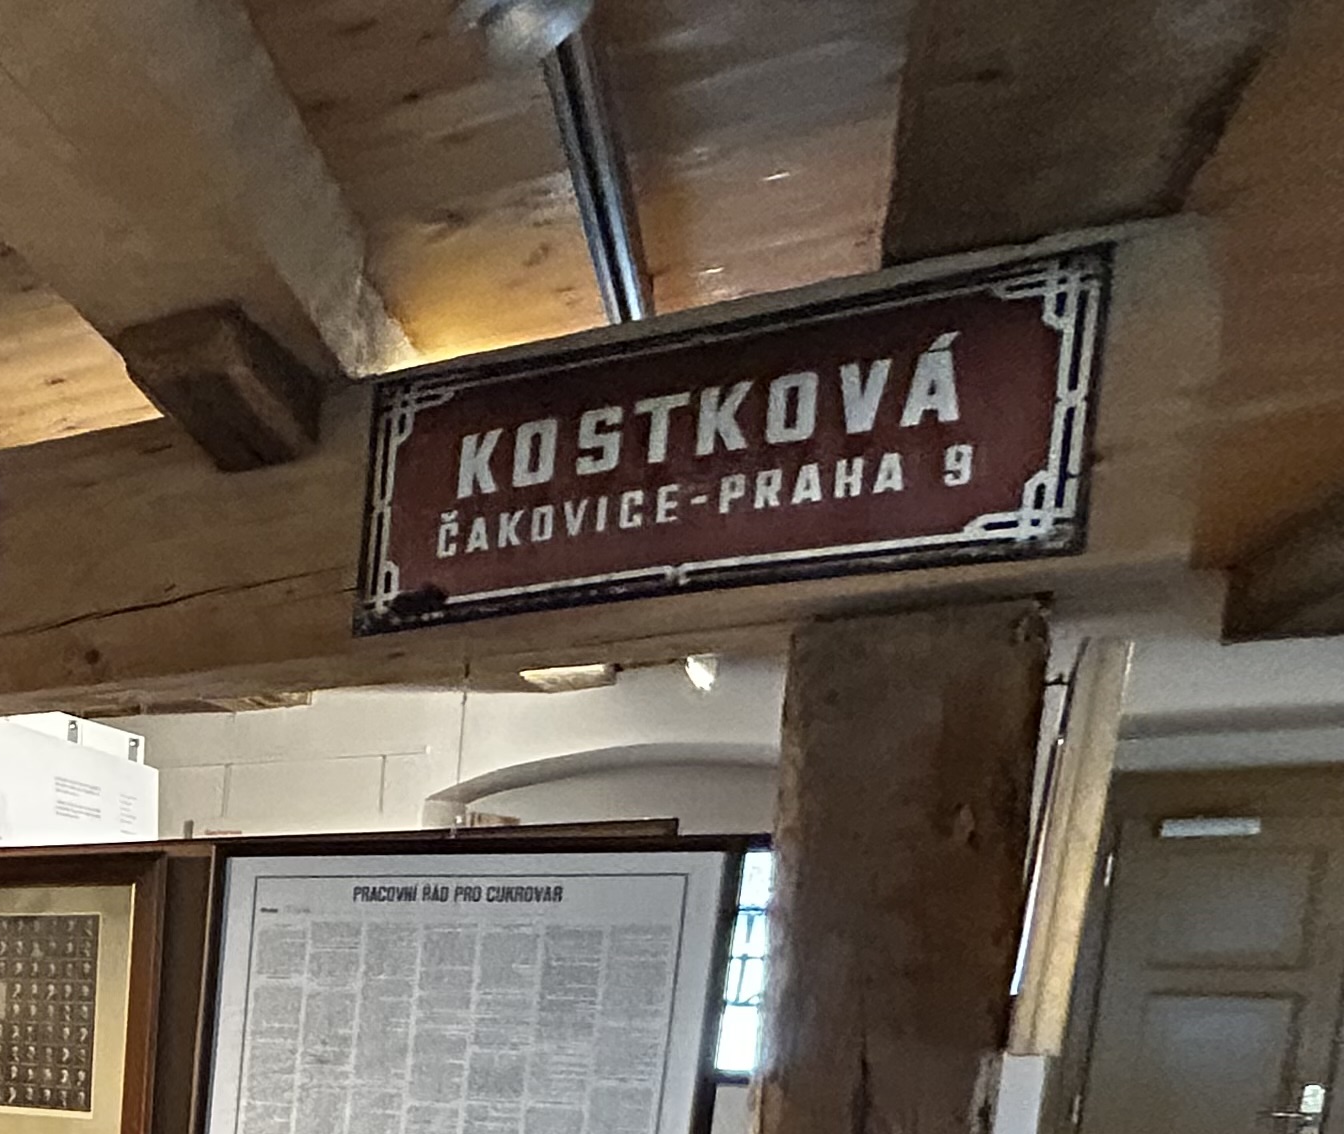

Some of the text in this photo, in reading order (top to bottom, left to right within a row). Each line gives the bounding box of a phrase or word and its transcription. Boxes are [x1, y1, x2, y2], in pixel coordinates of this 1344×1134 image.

[456, 331, 963, 499] KOSTKOVÁ
[436, 444, 975, 561] ČAKOVICE-PRAHA 9
[353, 882, 564, 903] PRACOVNÍ ŘÁD PRO CUKROVAR
